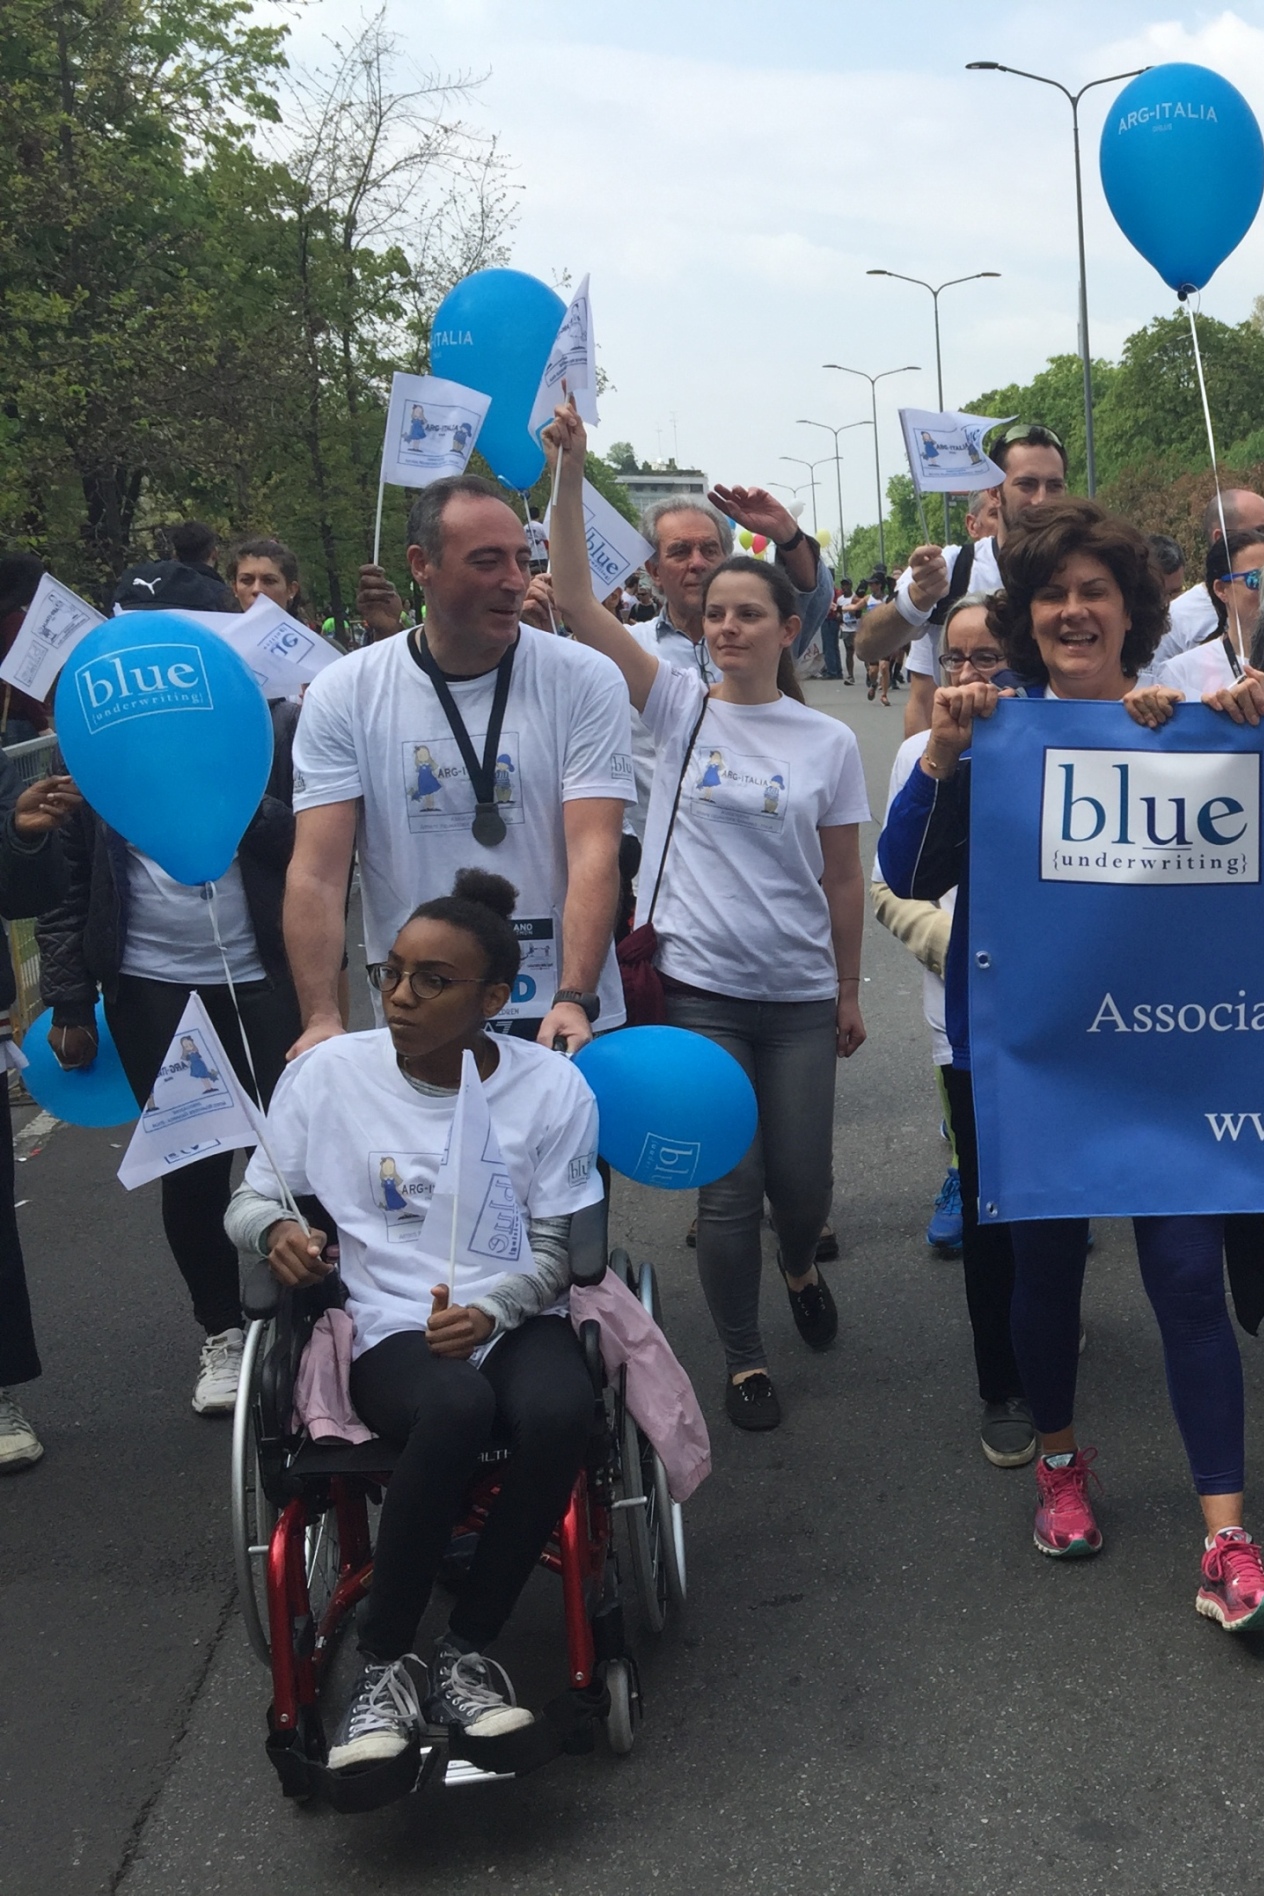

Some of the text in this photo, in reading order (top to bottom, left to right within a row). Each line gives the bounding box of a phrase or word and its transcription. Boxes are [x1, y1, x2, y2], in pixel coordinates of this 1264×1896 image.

[1117, 102, 1219, 136] ARG-ITALIA
[585, 532, 619, 575] blue
[82, 657, 199, 709] blue
[437, 766, 468, 778] ARG-I
[612, 755, 632, 774] blu
[721, 769, 769, 787] ARG-ITALIA
[1057, 763, 1249, 847] blue
[513, 923, 533, 932] ANO
[571, 1162, 589, 1180] blu
[401, 1184, 435, 1195] ARG-I
